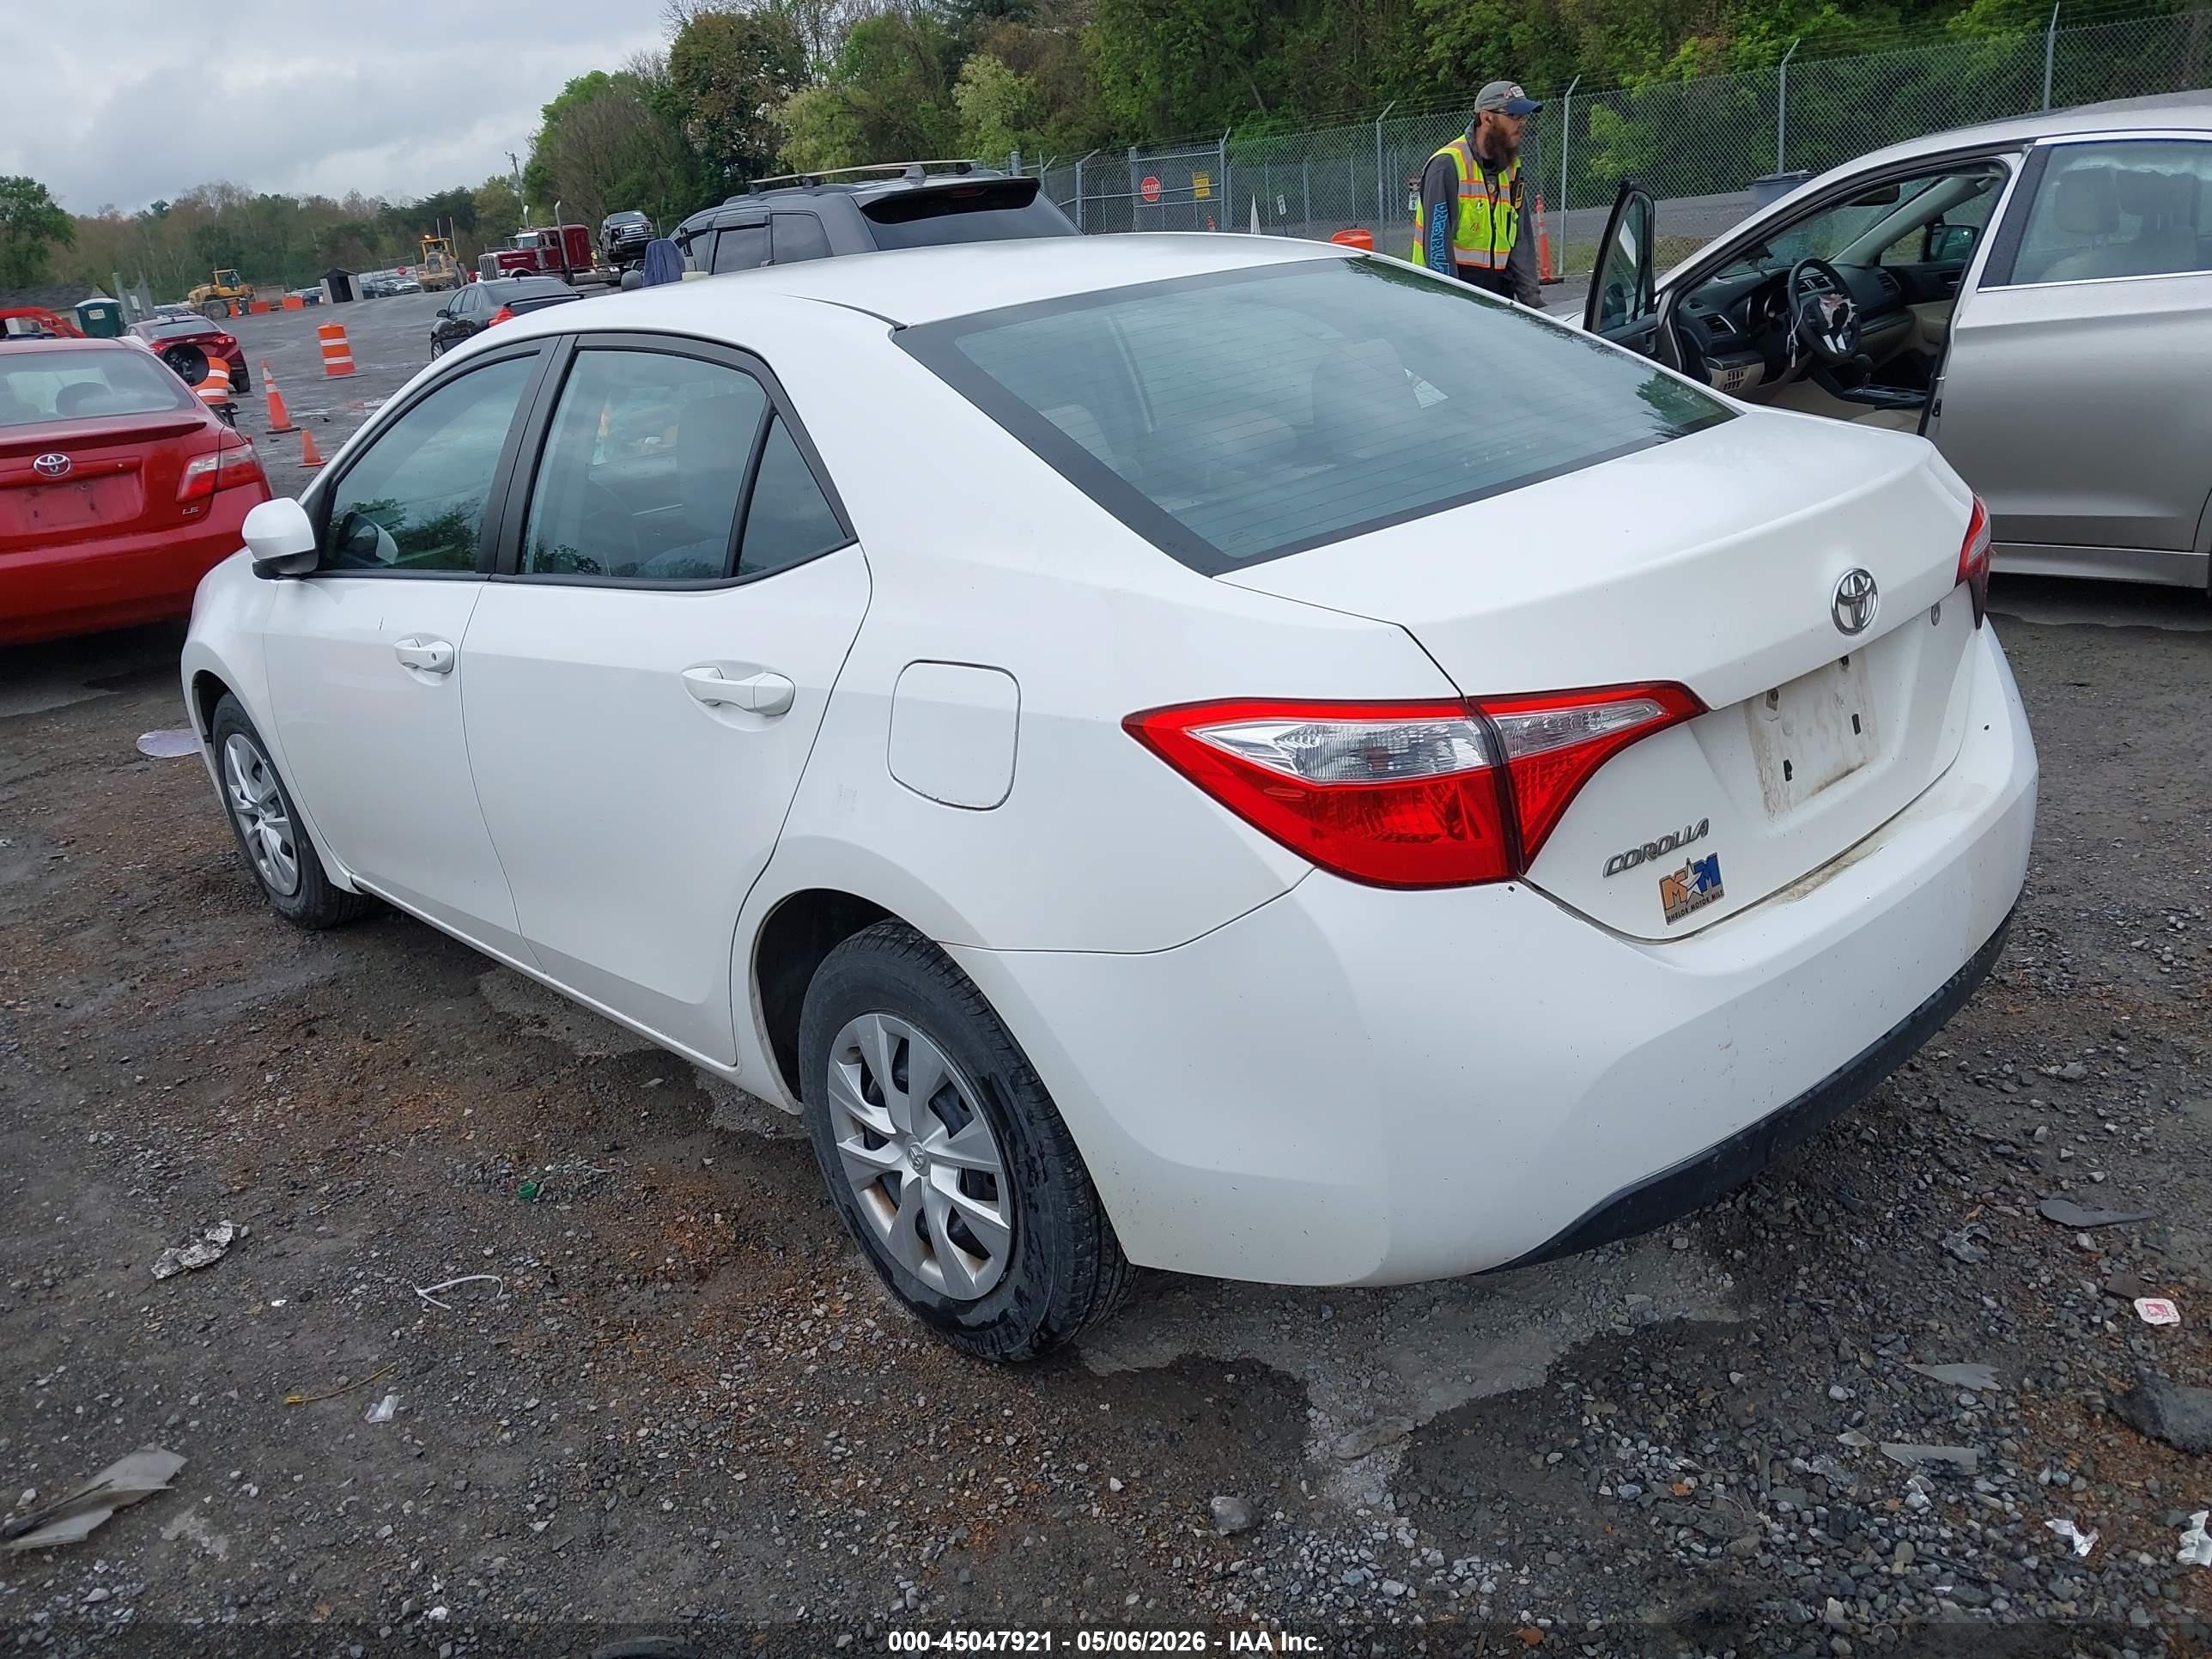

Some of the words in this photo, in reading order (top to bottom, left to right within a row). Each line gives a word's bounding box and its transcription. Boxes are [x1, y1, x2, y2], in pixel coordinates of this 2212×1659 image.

[1143, 184, 1159, 193] STOP
[1603, 817, 1709, 878] COROLLA
[1667, 907, 1689, 922] SHELOR
[1691, 896, 1710, 910] MOTOR
